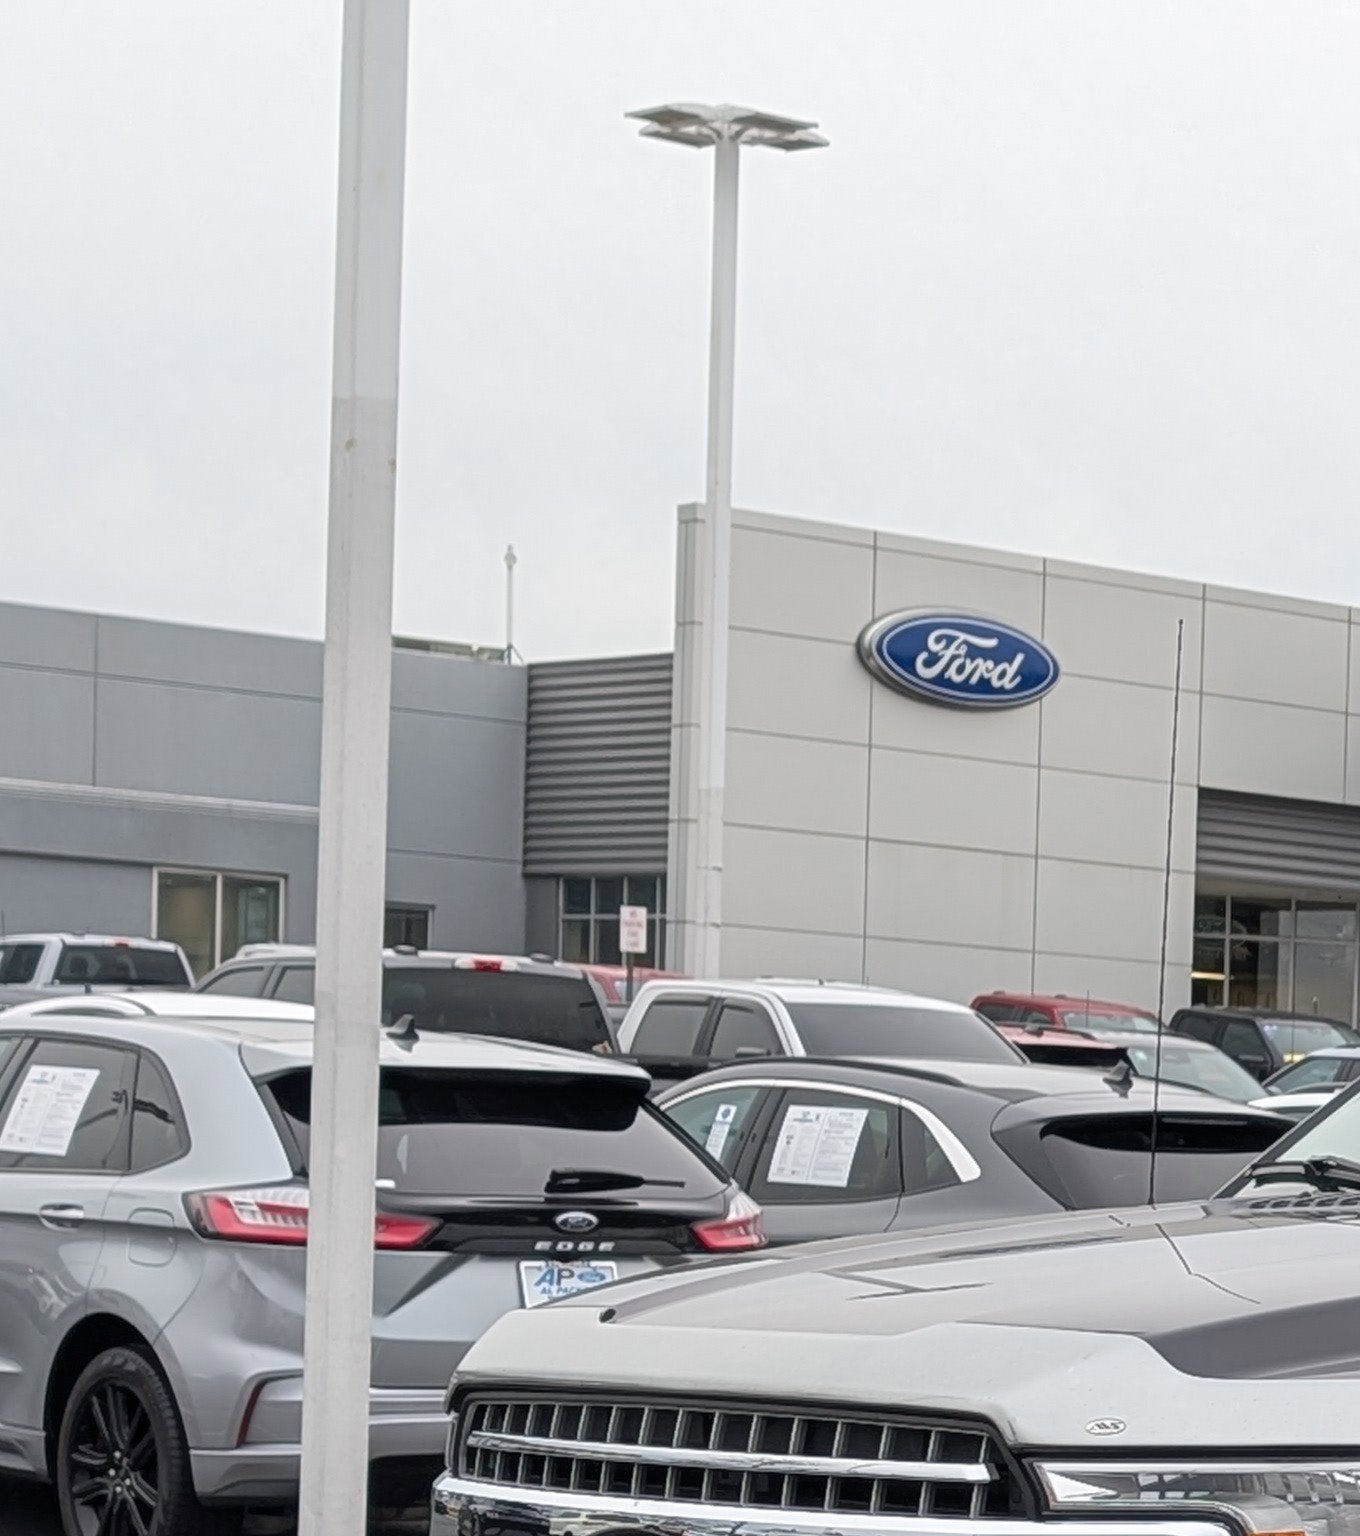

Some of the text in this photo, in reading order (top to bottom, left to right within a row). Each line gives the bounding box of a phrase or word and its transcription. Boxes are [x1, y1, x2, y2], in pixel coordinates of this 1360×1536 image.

[915, 628, 1025, 690] Ford
[534, 1241, 615, 1251] EDGE
[534, 1268, 575, 1286] AP
